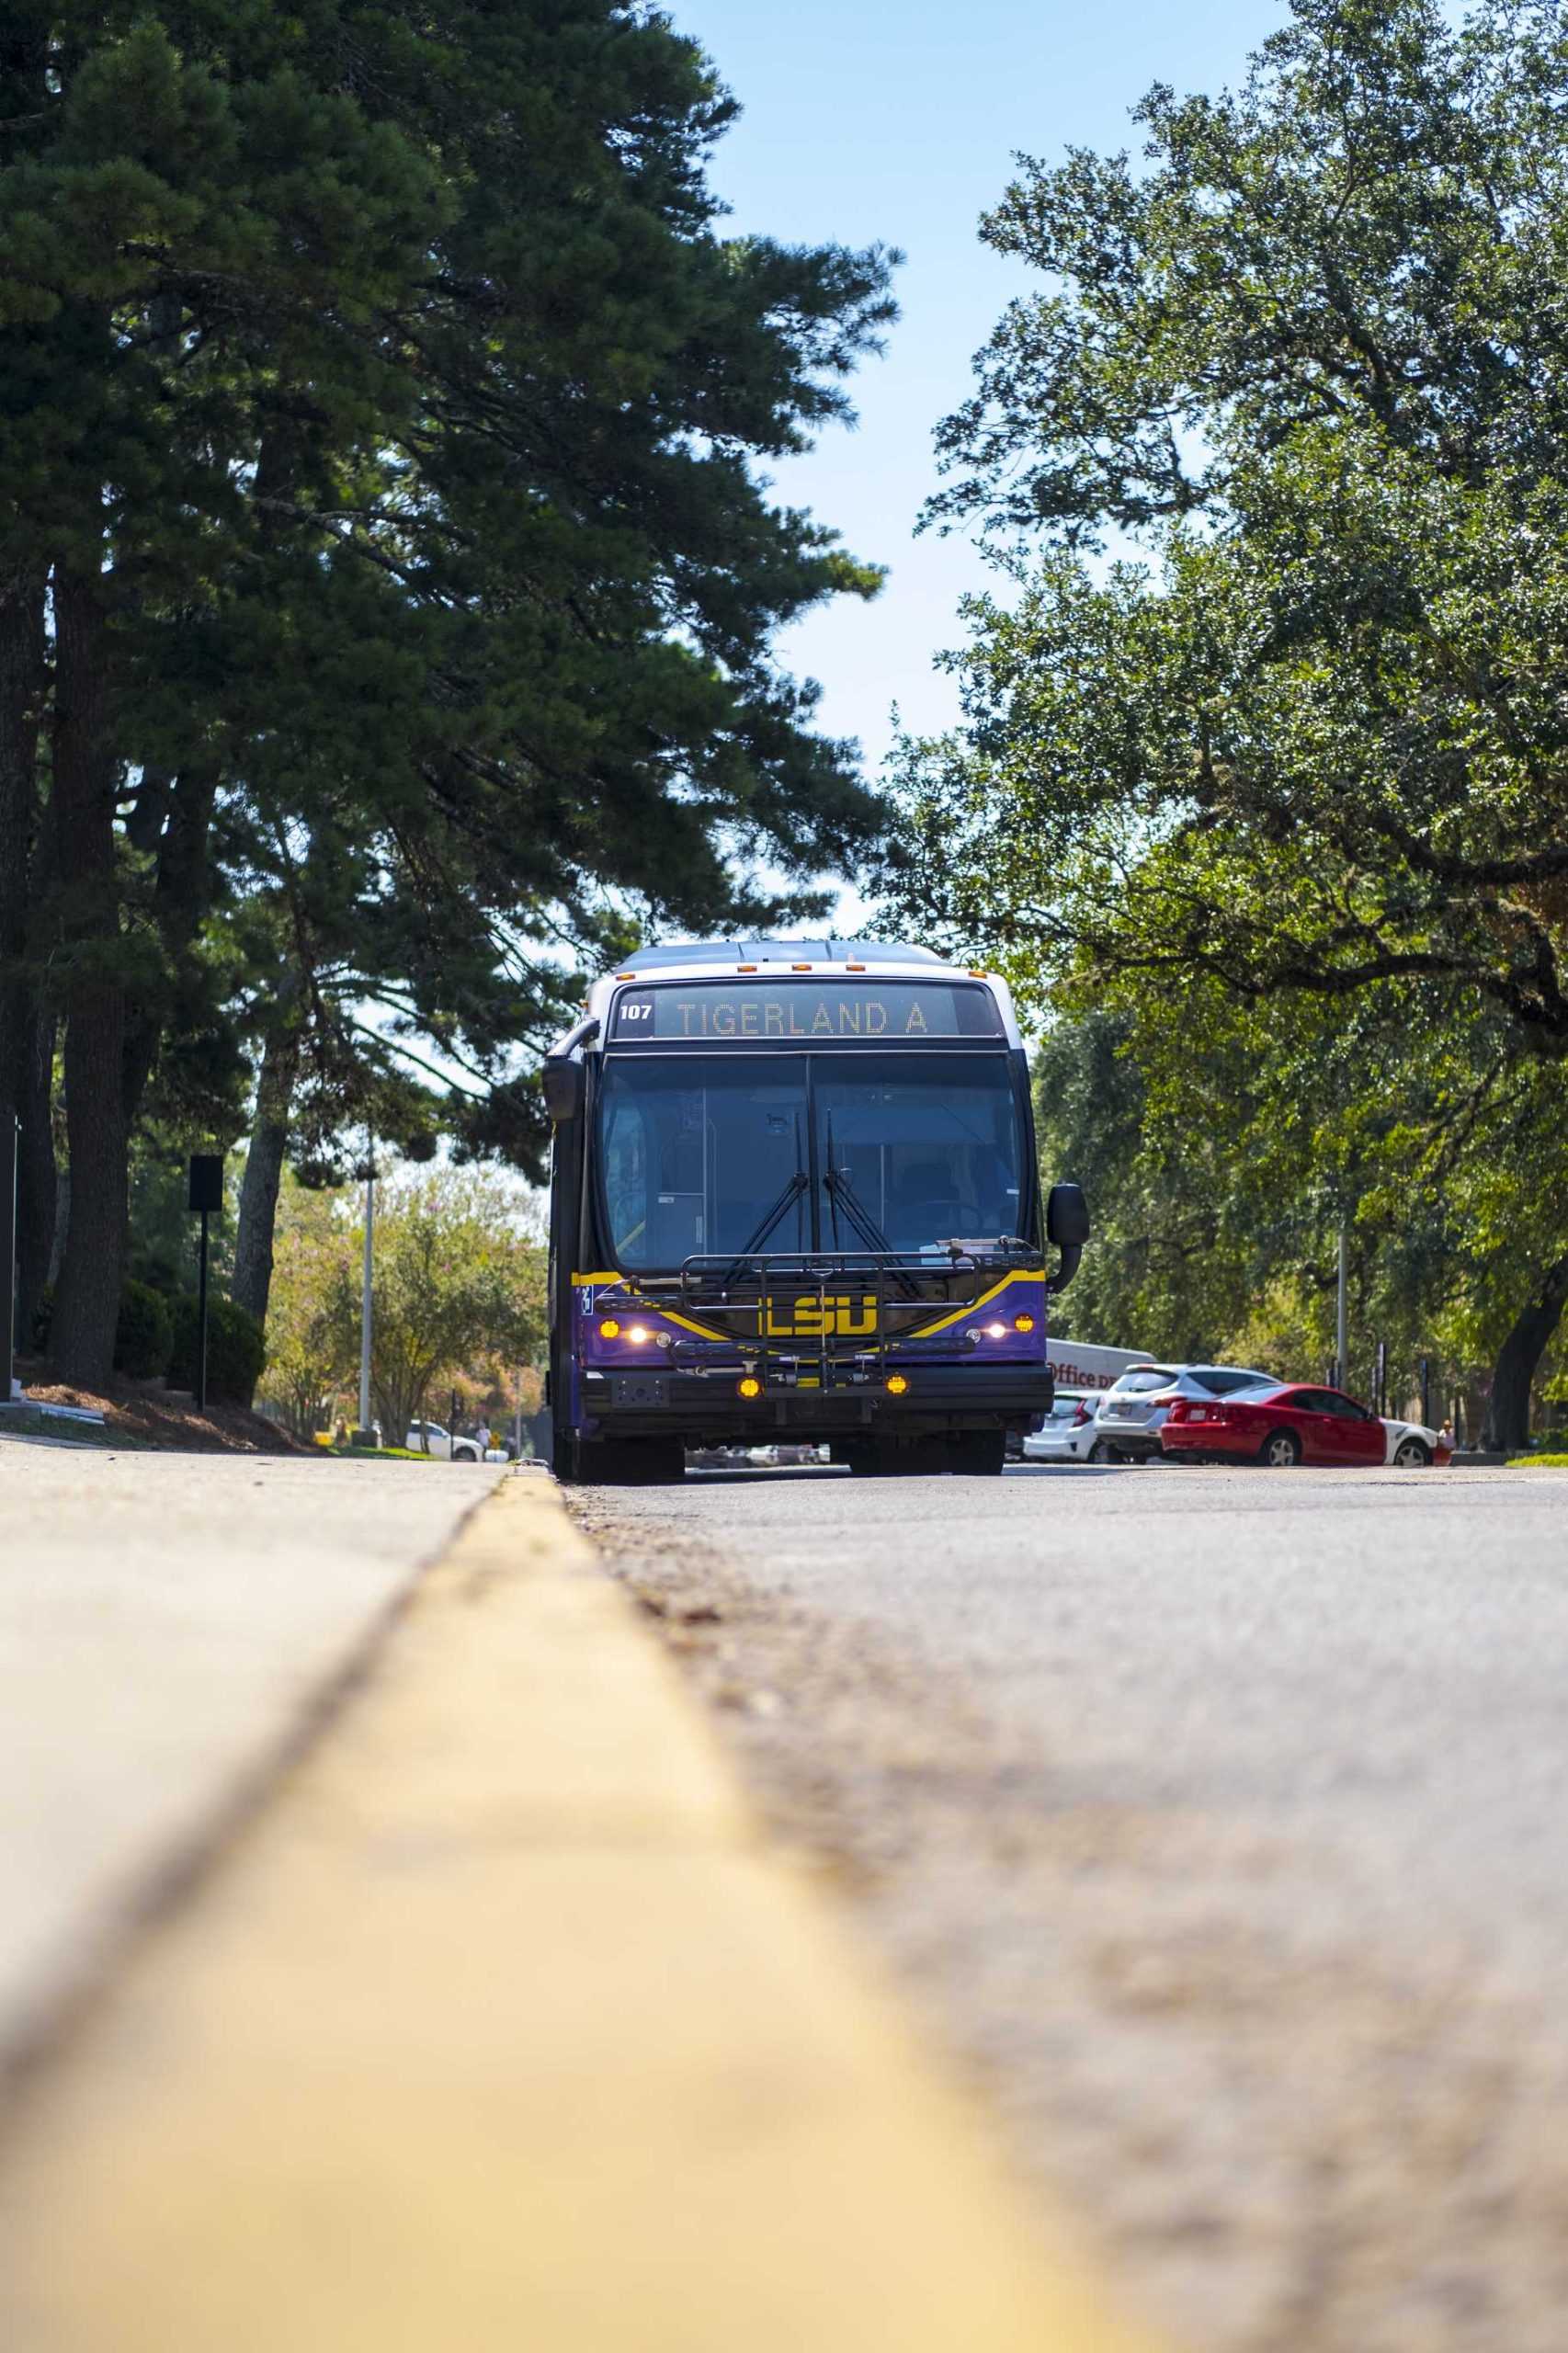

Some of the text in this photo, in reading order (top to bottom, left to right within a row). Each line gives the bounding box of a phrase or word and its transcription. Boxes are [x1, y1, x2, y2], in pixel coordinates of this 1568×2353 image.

[620, 1005, 653, 1020] 107
[676, 1002, 928, 1035] TIGERLAND A
[758, 1296, 878, 1336] LSU
